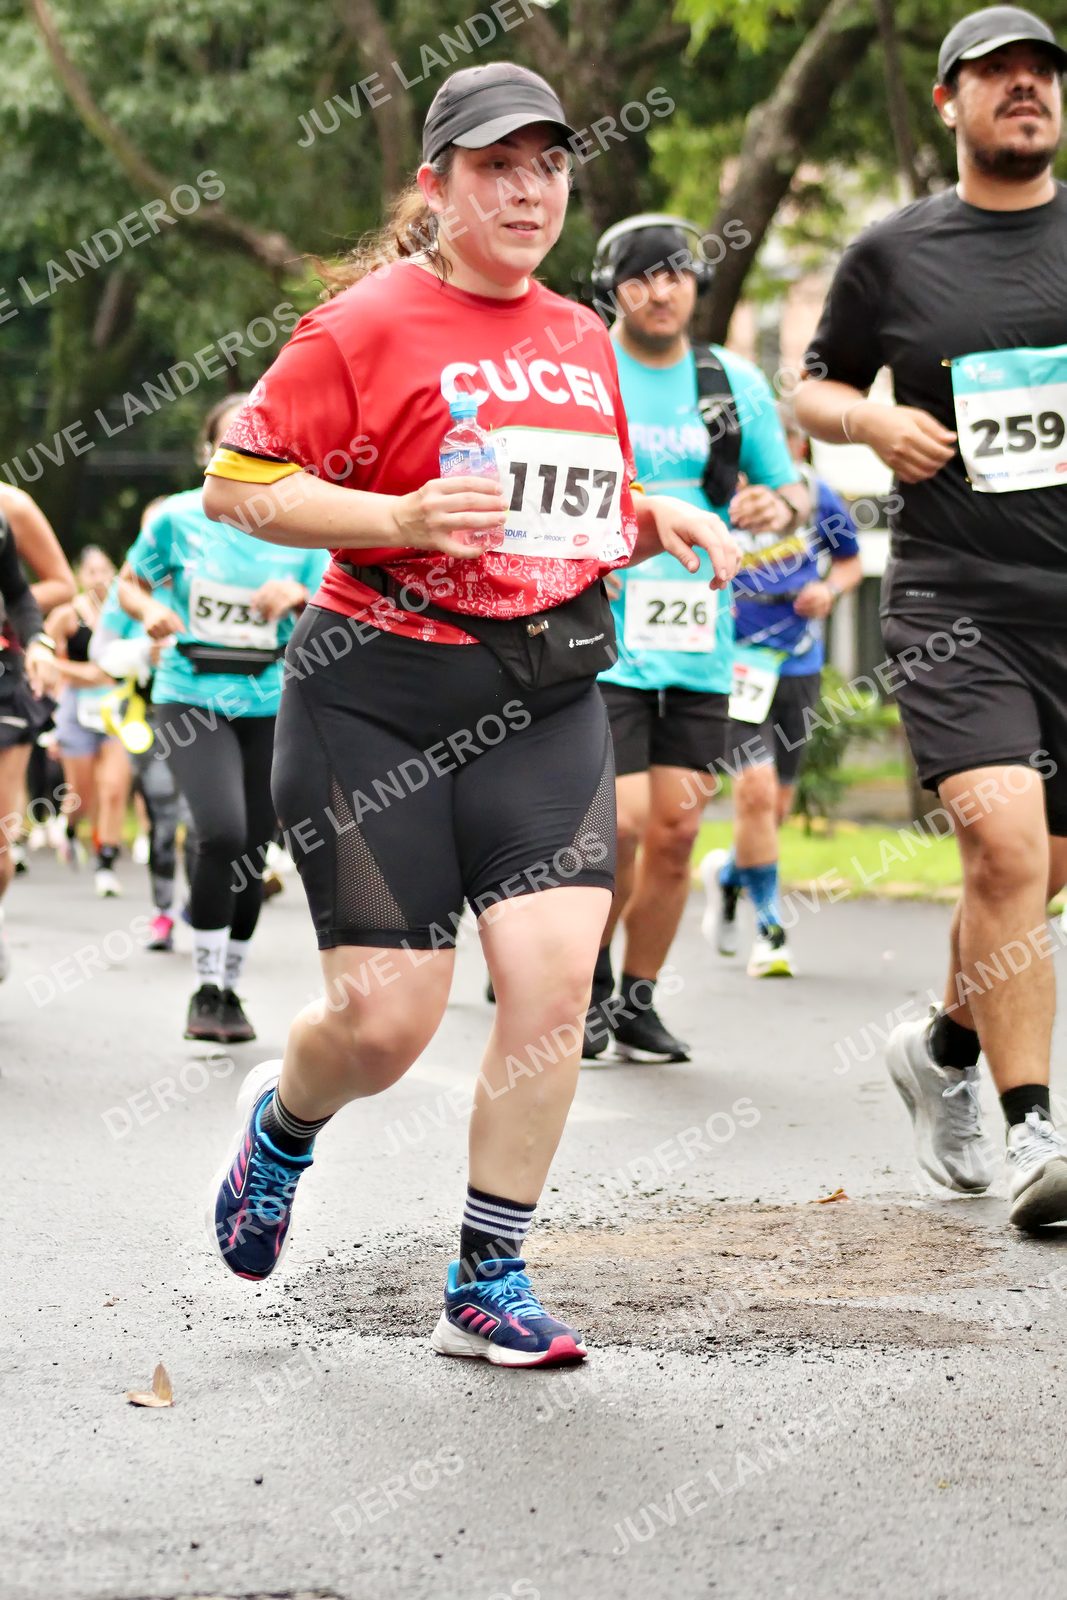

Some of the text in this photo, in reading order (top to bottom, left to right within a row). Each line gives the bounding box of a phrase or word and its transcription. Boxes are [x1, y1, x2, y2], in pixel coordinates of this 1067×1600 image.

[970, 411, 1065, 459] 259
[508, 461, 618, 519] 1157
[648, 600, 708, 626] 226
